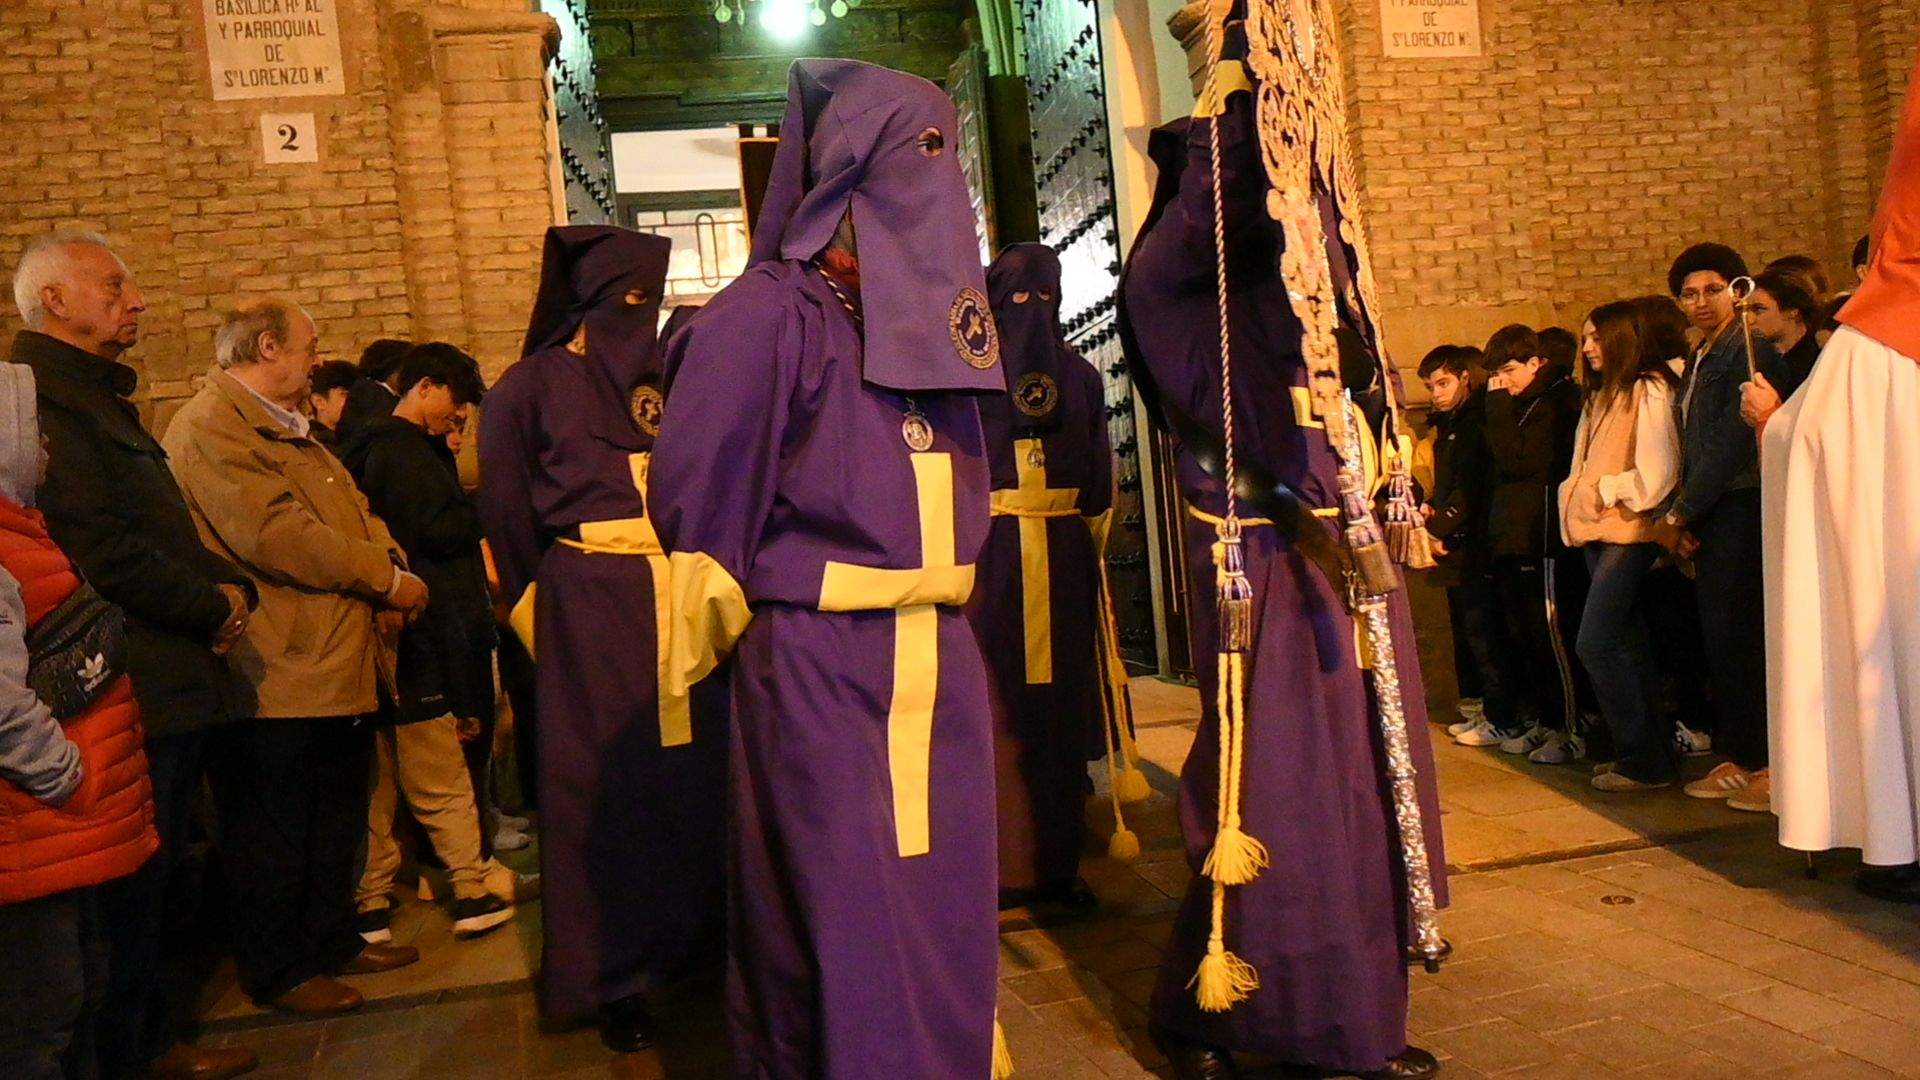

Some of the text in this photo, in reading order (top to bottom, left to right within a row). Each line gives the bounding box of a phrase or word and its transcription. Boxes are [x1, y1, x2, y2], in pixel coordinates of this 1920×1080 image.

[215, 0, 280, 16] BASILICA
[1423, 11, 1438, 27] DE
[218, 20, 325, 40] Y PARROQUIAL
[1404, 31, 1455, 47] LORENZO
[265, 44, 284, 62] DE
[239, 67, 310, 87] LORENZO
[277, 123, 300, 151] 2
